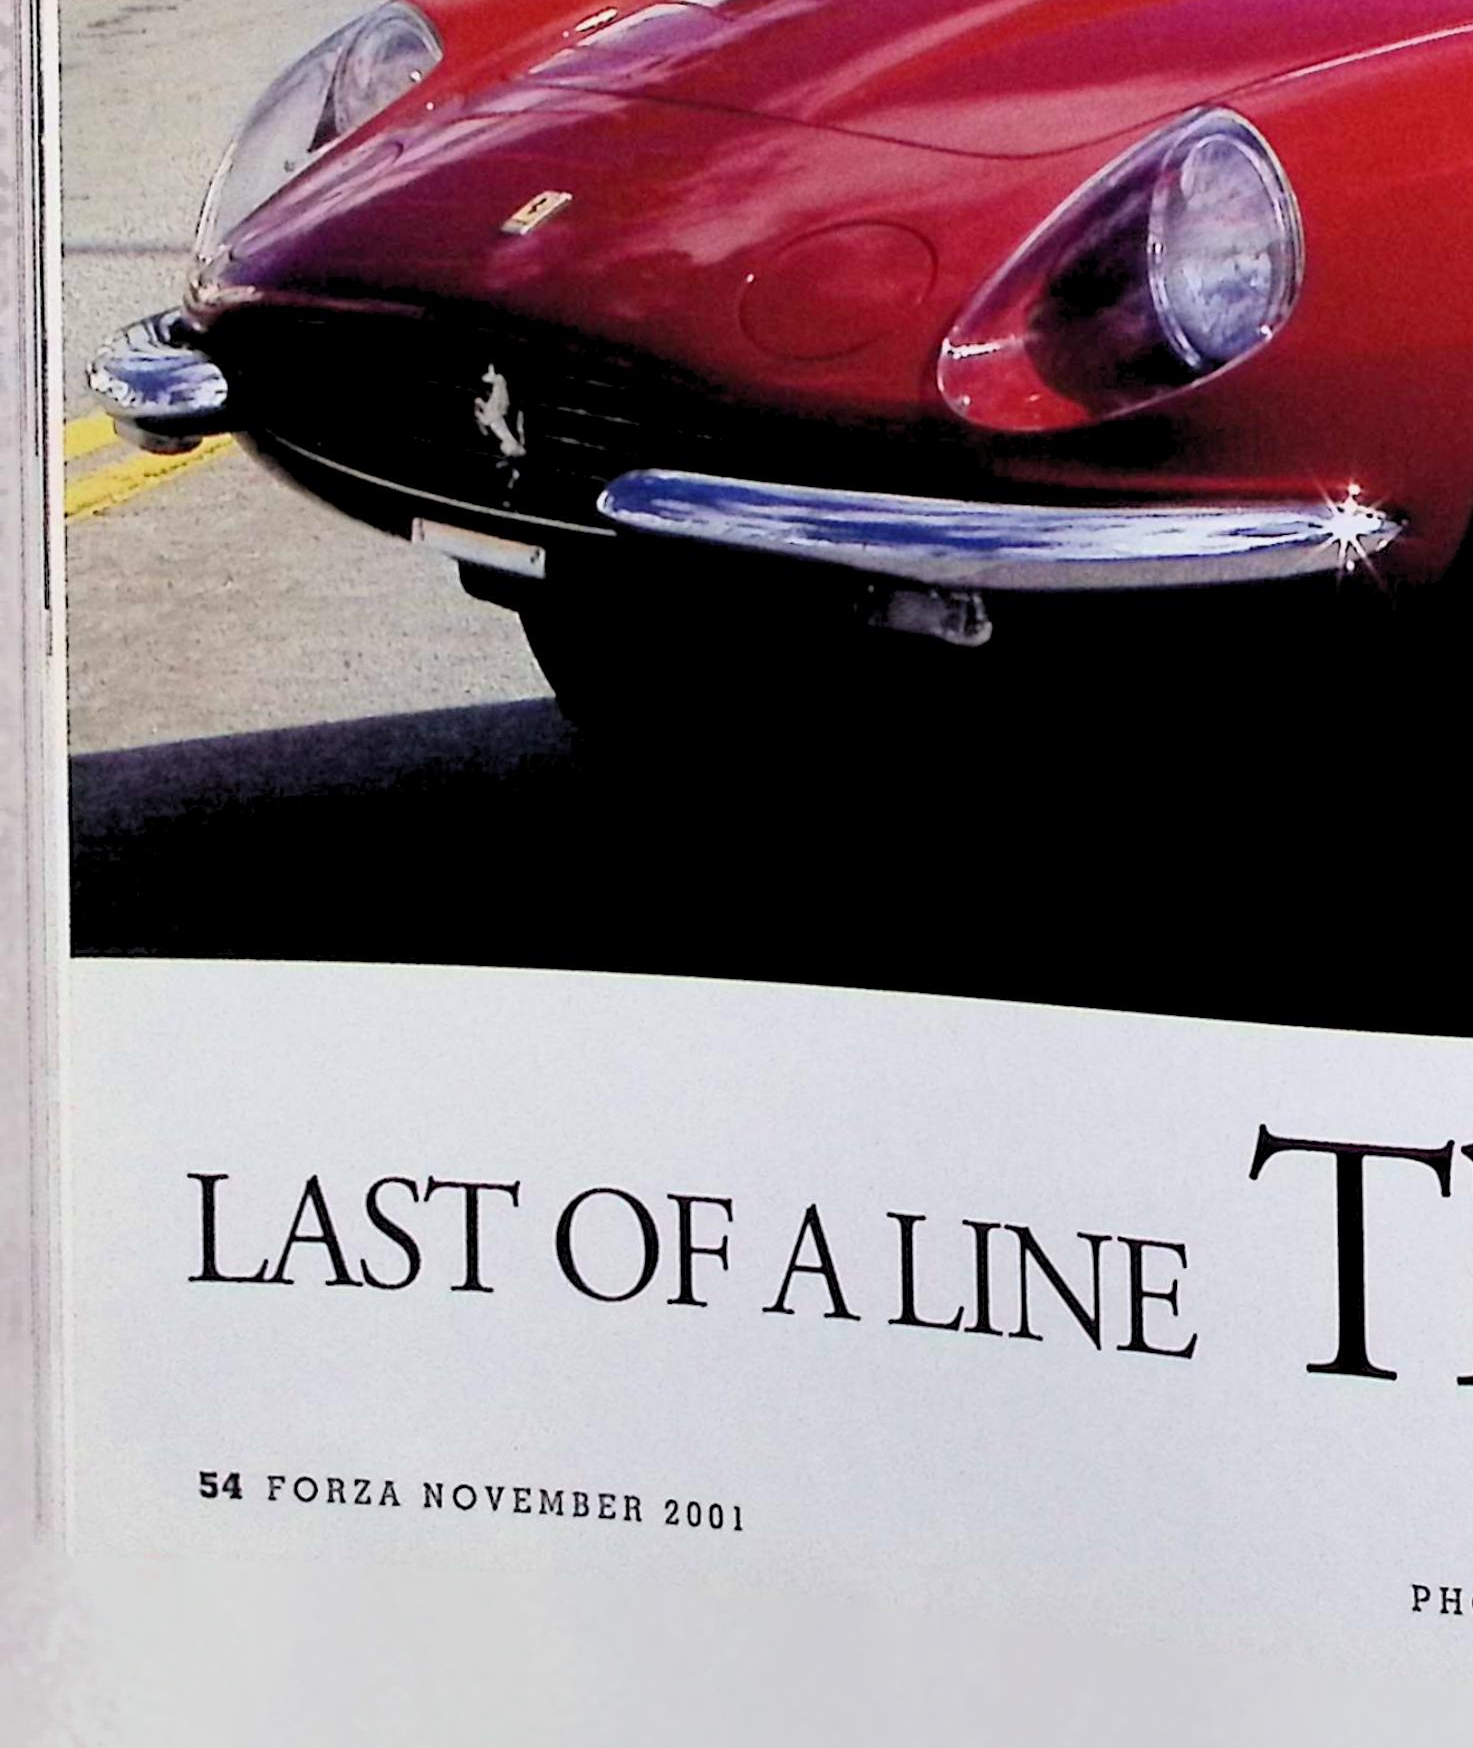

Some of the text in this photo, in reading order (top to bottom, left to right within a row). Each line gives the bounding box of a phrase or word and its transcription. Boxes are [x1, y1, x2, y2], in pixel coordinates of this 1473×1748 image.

[187, 1173, 1197, 1359] LAST OF A LINE
[199, 1471, 743, 1531] 54 FORZA NOVEMBER 2001
